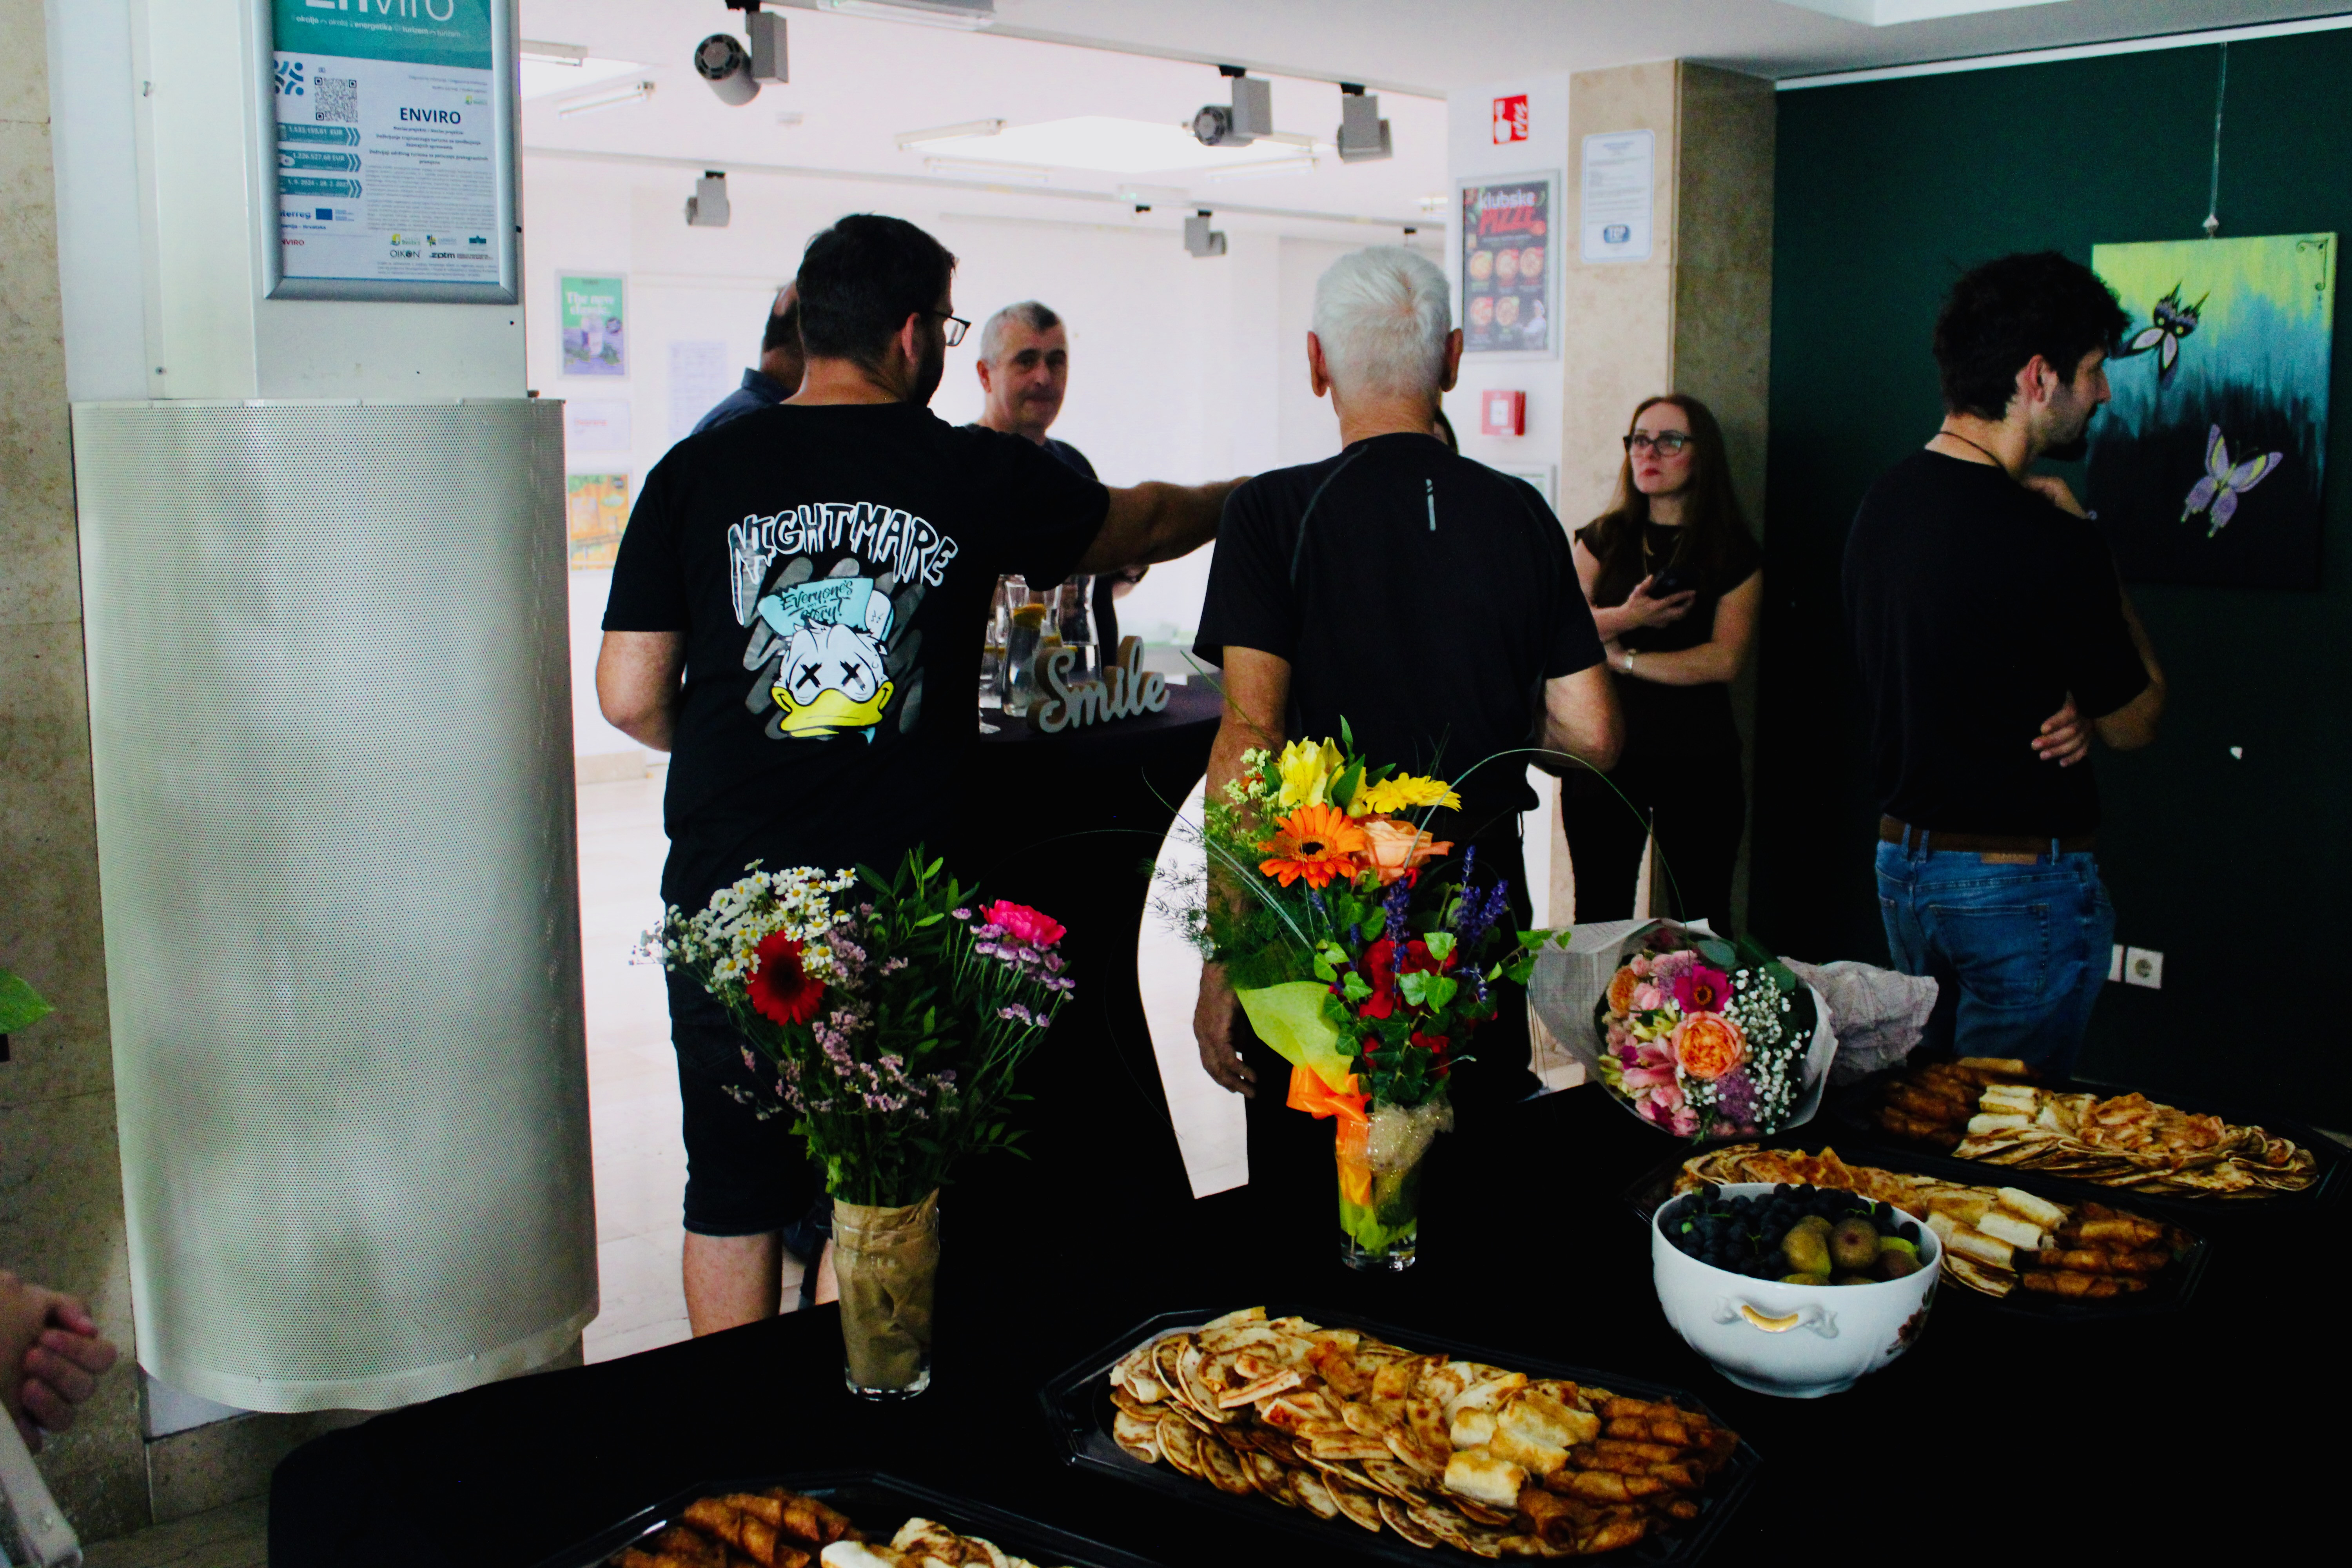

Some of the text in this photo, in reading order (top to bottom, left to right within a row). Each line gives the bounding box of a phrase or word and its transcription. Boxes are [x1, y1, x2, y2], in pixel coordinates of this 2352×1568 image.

[400, 107, 461, 124] ENVIRO
[1477, 190, 1536, 210] klubske
[728, 501, 958, 626] NIGHTMARE
[781, 579, 853, 611] Everyone's
[1027, 635, 1171, 733] Smile
